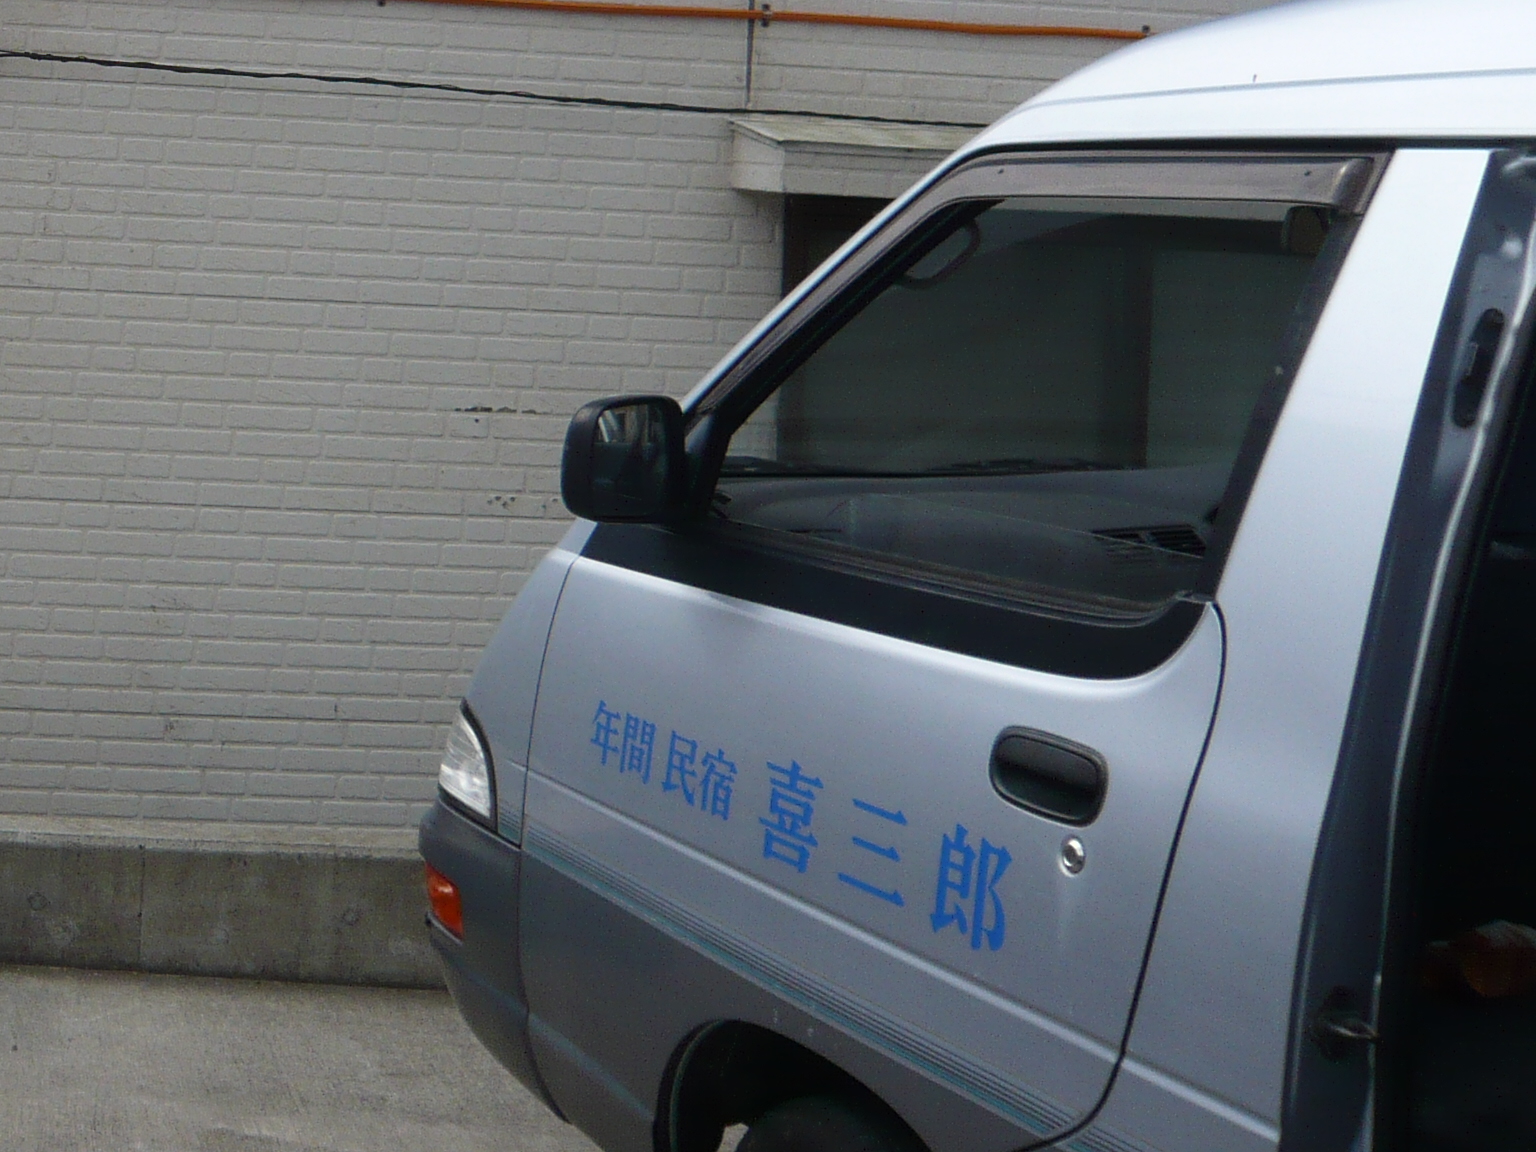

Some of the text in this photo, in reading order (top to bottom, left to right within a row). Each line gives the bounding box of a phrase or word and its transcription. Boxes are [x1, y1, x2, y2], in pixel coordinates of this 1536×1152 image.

[590, 699, 1013, 952] 年間民宿 喜三郎
